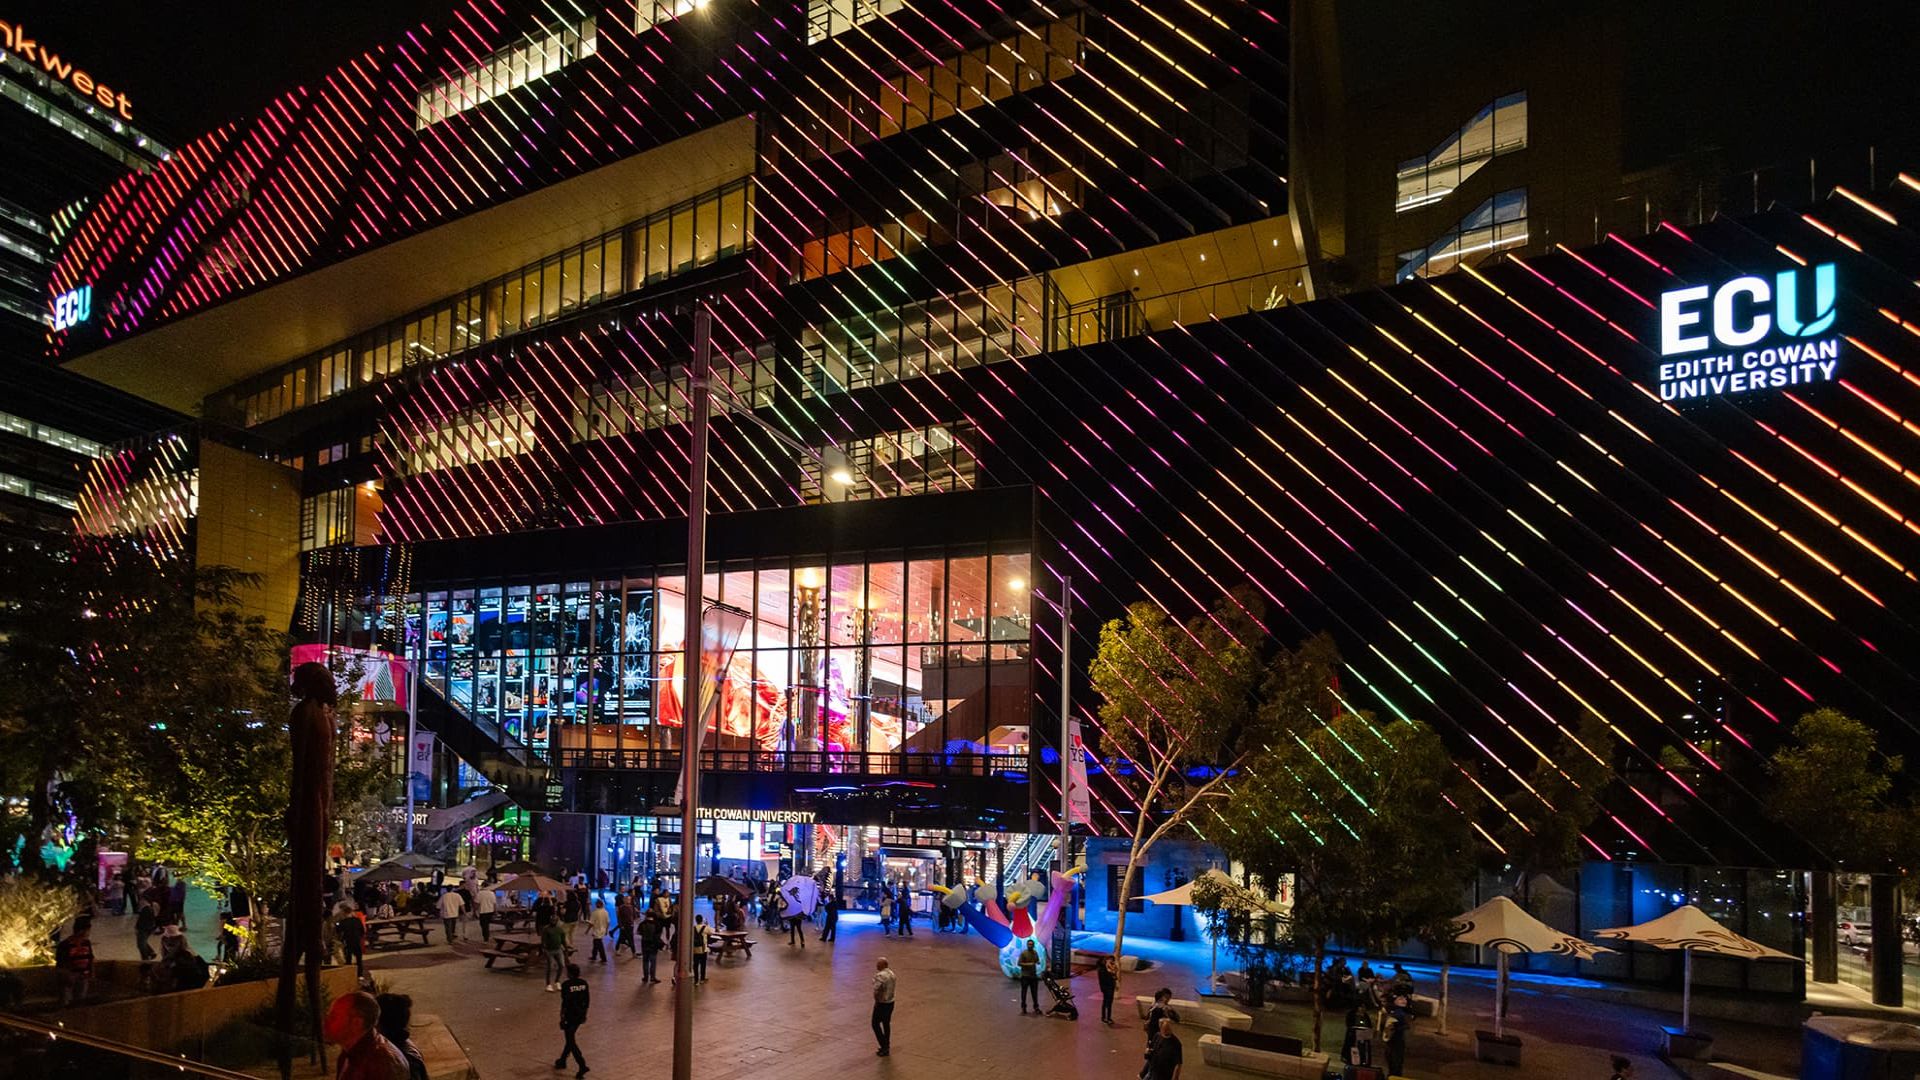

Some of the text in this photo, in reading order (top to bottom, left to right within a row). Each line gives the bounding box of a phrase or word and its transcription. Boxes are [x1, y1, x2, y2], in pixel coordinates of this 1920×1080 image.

[55, 285, 91, 331] ECU
[1661, 262, 1836, 356] ECU
[1659, 339, 1837, 381] EDITH COWAN
[1659, 360, 1837, 401] UNIVERSITY
[713, 808, 751, 821] COWAN
[752, 809, 816, 824] UNIVERSITY
